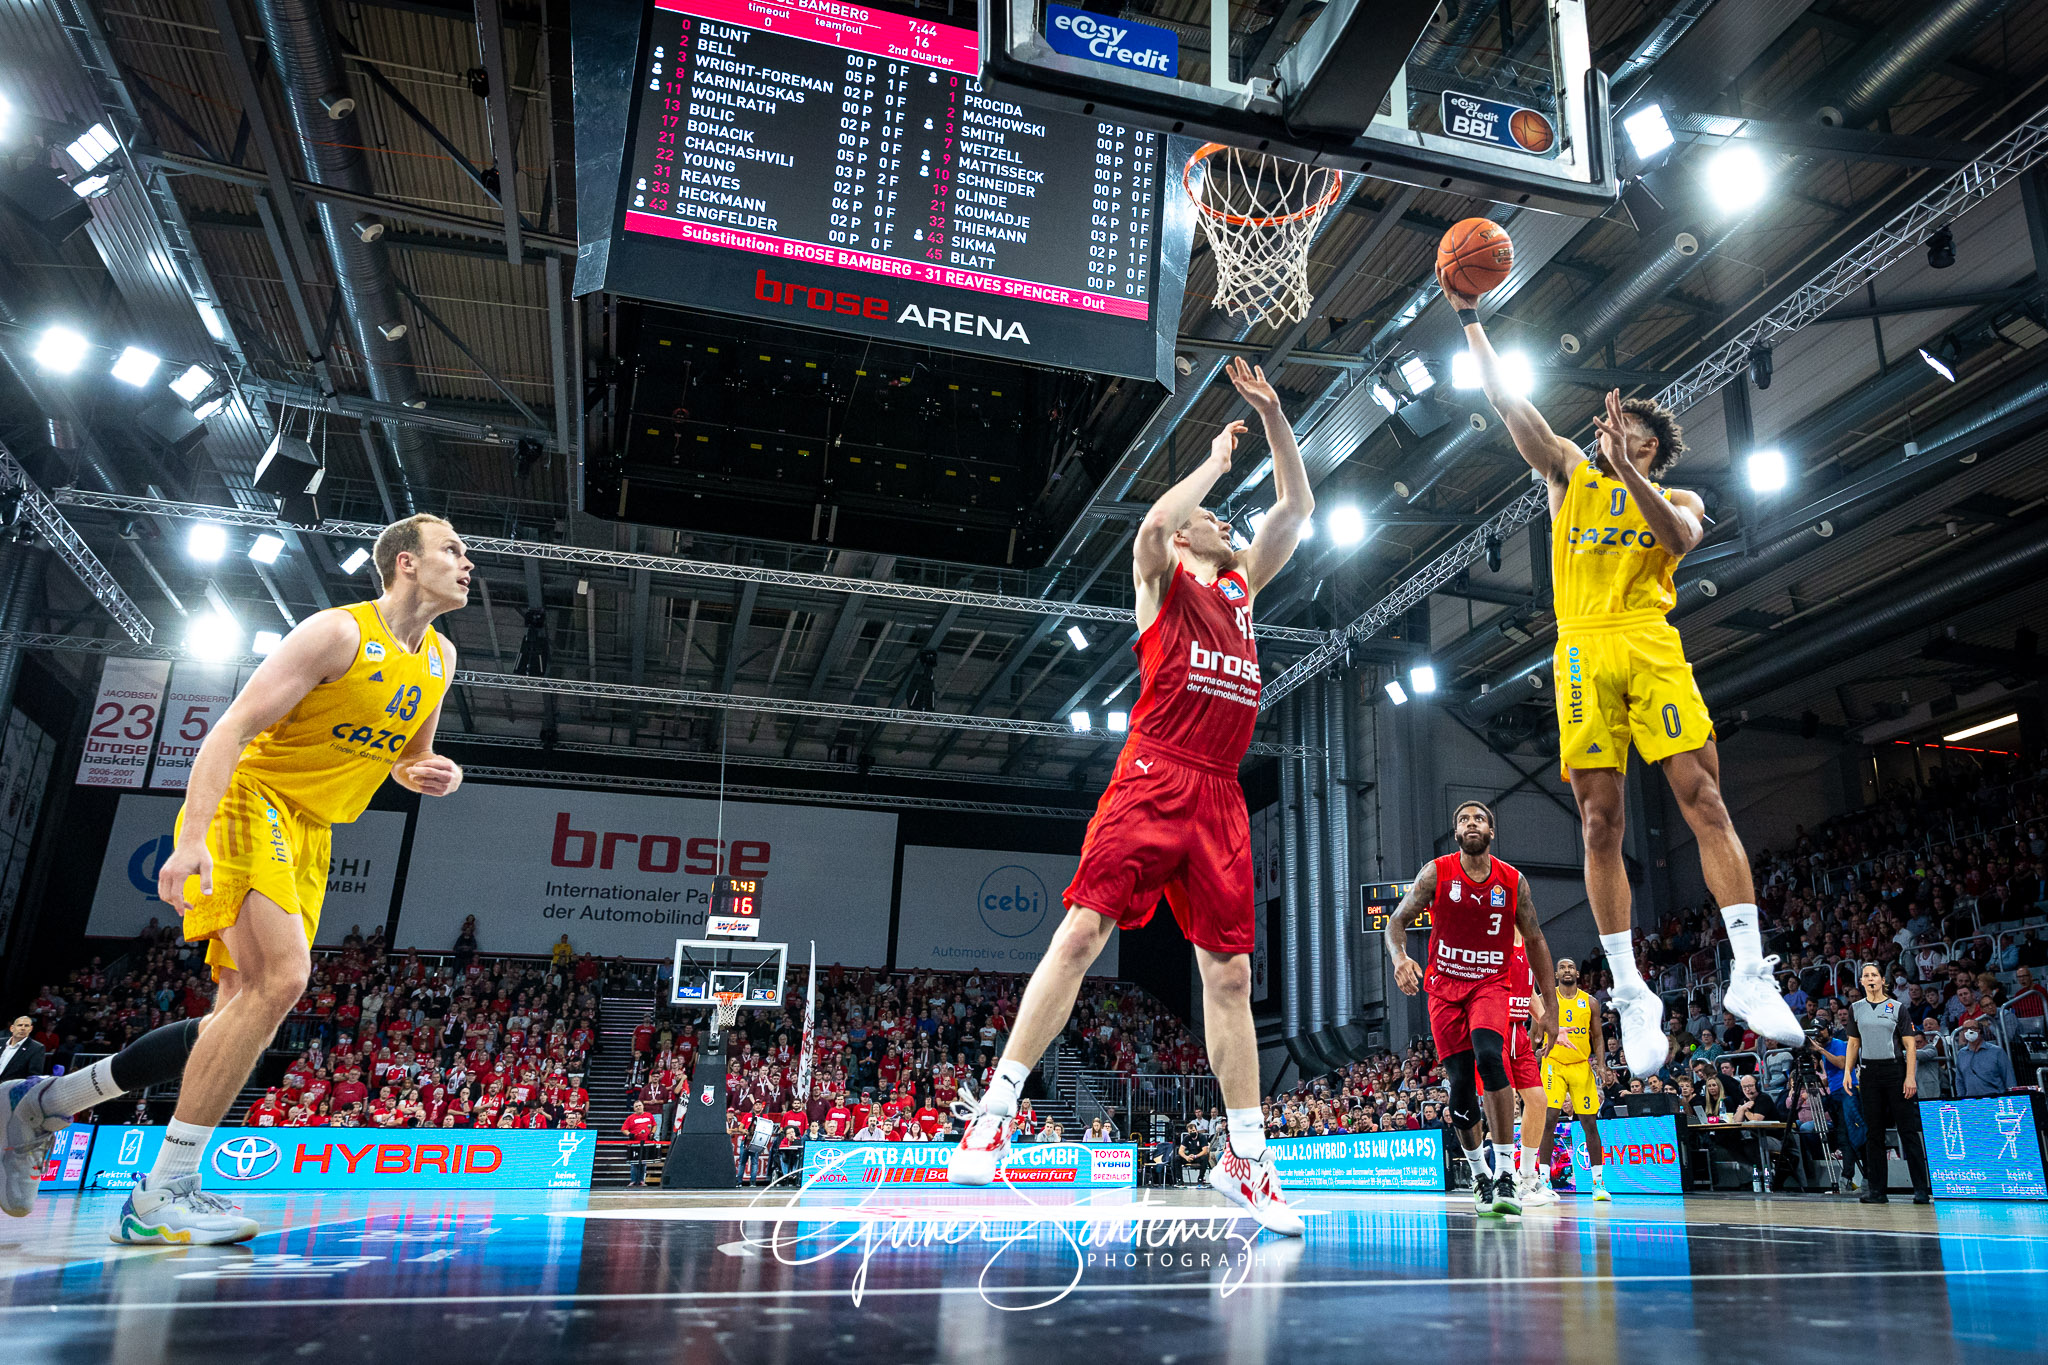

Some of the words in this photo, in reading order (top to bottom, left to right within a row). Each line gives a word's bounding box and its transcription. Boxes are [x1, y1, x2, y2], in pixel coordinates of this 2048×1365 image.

[748, 2, 790, 19] timeout
[764, 17, 772, 27] 0
[682, 20, 691, 30] 0
[700, 22, 750, 43] BLUNT
[815, 17, 862, 35] teamfoul
[835, 32, 841, 42] 1
[908, 20, 937, 37] 7:44
[680, 36, 689, 46] 2
[698, 39, 736, 57] BELL
[914, 35, 930, 48] 16
[888, 43, 909, 57] 2nd
[911, 48, 954, 66] Quarter
[1089, 38, 1169, 71] Credit
[678, 52, 686, 62] 3
[696, 54, 834, 93] WRIGHT-FOREMAN
[950, 77, 957, 87] 0
[676, 68, 684, 78] 8
[693, 70, 805, 104] KARINIAUSKAS
[666, 82, 681, 94] 11
[691, 87, 776, 114] WOHLRATH
[949, 92, 955, 102] 1
[964, 96, 1023, 117] PROCIDA
[664, 98, 680, 110] 13
[689, 103, 735, 123] BULIC
[1466, 108, 1499, 122] Credit
[662, 115, 679, 127] 17
[687, 120, 754, 143] BOHACIK
[946, 123, 954, 134] 3
[961, 126, 1004, 145] SMITH
[947, 108, 955, 118] 2
[963, 111, 1045, 137] MACHOWSKI
[1453, 115, 1499, 140] BBL
[656, 148, 674, 160] 22
[683, 152, 736, 173] YOUNG
[658, 131, 675, 143] 21
[685, 136, 794, 168] CHACHASHVILI
[944, 138, 952, 148] 7
[960, 142, 1023, 164] WETZELL
[653, 165, 670, 177] 31
[681, 168, 741, 190] REAVES
[943, 154, 950, 164] 9
[959, 158, 1044, 183] MATTISSECK
[935, 168, 949, 180] 10
[957, 173, 1036, 197] SCHNEIDER
[652, 182, 670, 194] 33
[679, 186, 766, 212] HECKMANN
[933, 184, 948, 196] 19
[956, 189, 1007, 208] OLINDE
[649, 199, 667, 210] 43
[676, 202, 778, 231] SENGFELDER
[930, 200, 946, 212] 21
[954, 205, 1030, 228] KOUMADJE
[929, 217, 945, 228] 32
[954, 220, 1026, 243] THIEMANN
[927, 233, 944, 244] 43
[951, 237, 996, 254] SIKMA
[682, 225, 779, 254] Substitution:
[783, 242, 835, 260] BROSE
[838, 254, 912, 276] BAMBERG
[925, 268, 941, 281] 31
[945, 271, 1001, 292] REAVES
[1004, 282, 1069, 304] SPENCER
[1082, 296, 1105, 310] Out
[926, 249, 942, 260] 45
[951, 253, 995, 270] BLATT
[755, 269, 889, 320] brose
[897, 304, 1031, 344] ARENA
[1610, 487, 1626, 516] 0
[1568, 526, 1656, 549] CAZOO
[103, 689, 158, 700] JACOBSEN
[1567, 646, 1582, 725] interzero
[169, 692, 232, 703] GOLDSBERRY
[385, 684, 422, 721] 43
[90, 702, 155, 740] 23
[179, 706, 210, 741] 5
[1661, 703, 1682, 739] 0
[86, 738, 148, 755] brose
[84, 753, 145, 767] baskets
[88, 767, 135, 777] 2006-2007
[550, 812, 771, 878] brose
[545, 881, 681, 904] Internationaler
[984, 886, 1039, 914] cebi
[542, 903, 575, 920] der
[733, 896, 754, 915] 16
[1367, 906, 1382, 915] BAM
[1487, 913, 1503, 935] 3
[932, 945, 1005, 962] Automotive
[1438, 939, 1504, 965] brose
[1477, 966, 1499, 974] Partner
[1566, 1009, 1573, 1022] 3
[1583, 1096, 1591, 1109] 3
[292, 1143, 503, 1174] HYBRID
[1029, 1147, 1079, 1165] GMBH
[1094, 1150, 1131, 1159] TOYOTA
[1313, 1142, 1347, 1160] HYBRID
[1353, 1140, 1371, 1158] 135
[1372, 1139, 1388, 1158] kW
[1390, 1138, 1415, 1161] (184
[1416, 1137, 1437, 1160] PS)
[1601, 1143, 1676, 1165] HYBRID
[555, 1171, 576, 1180] keine
[809, 1174, 848, 1183] TOYOTA
[994, 1170, 1074, 1181] Schweinfurt
[1093, 1173, 1131, 1181] SPEZIALIST
